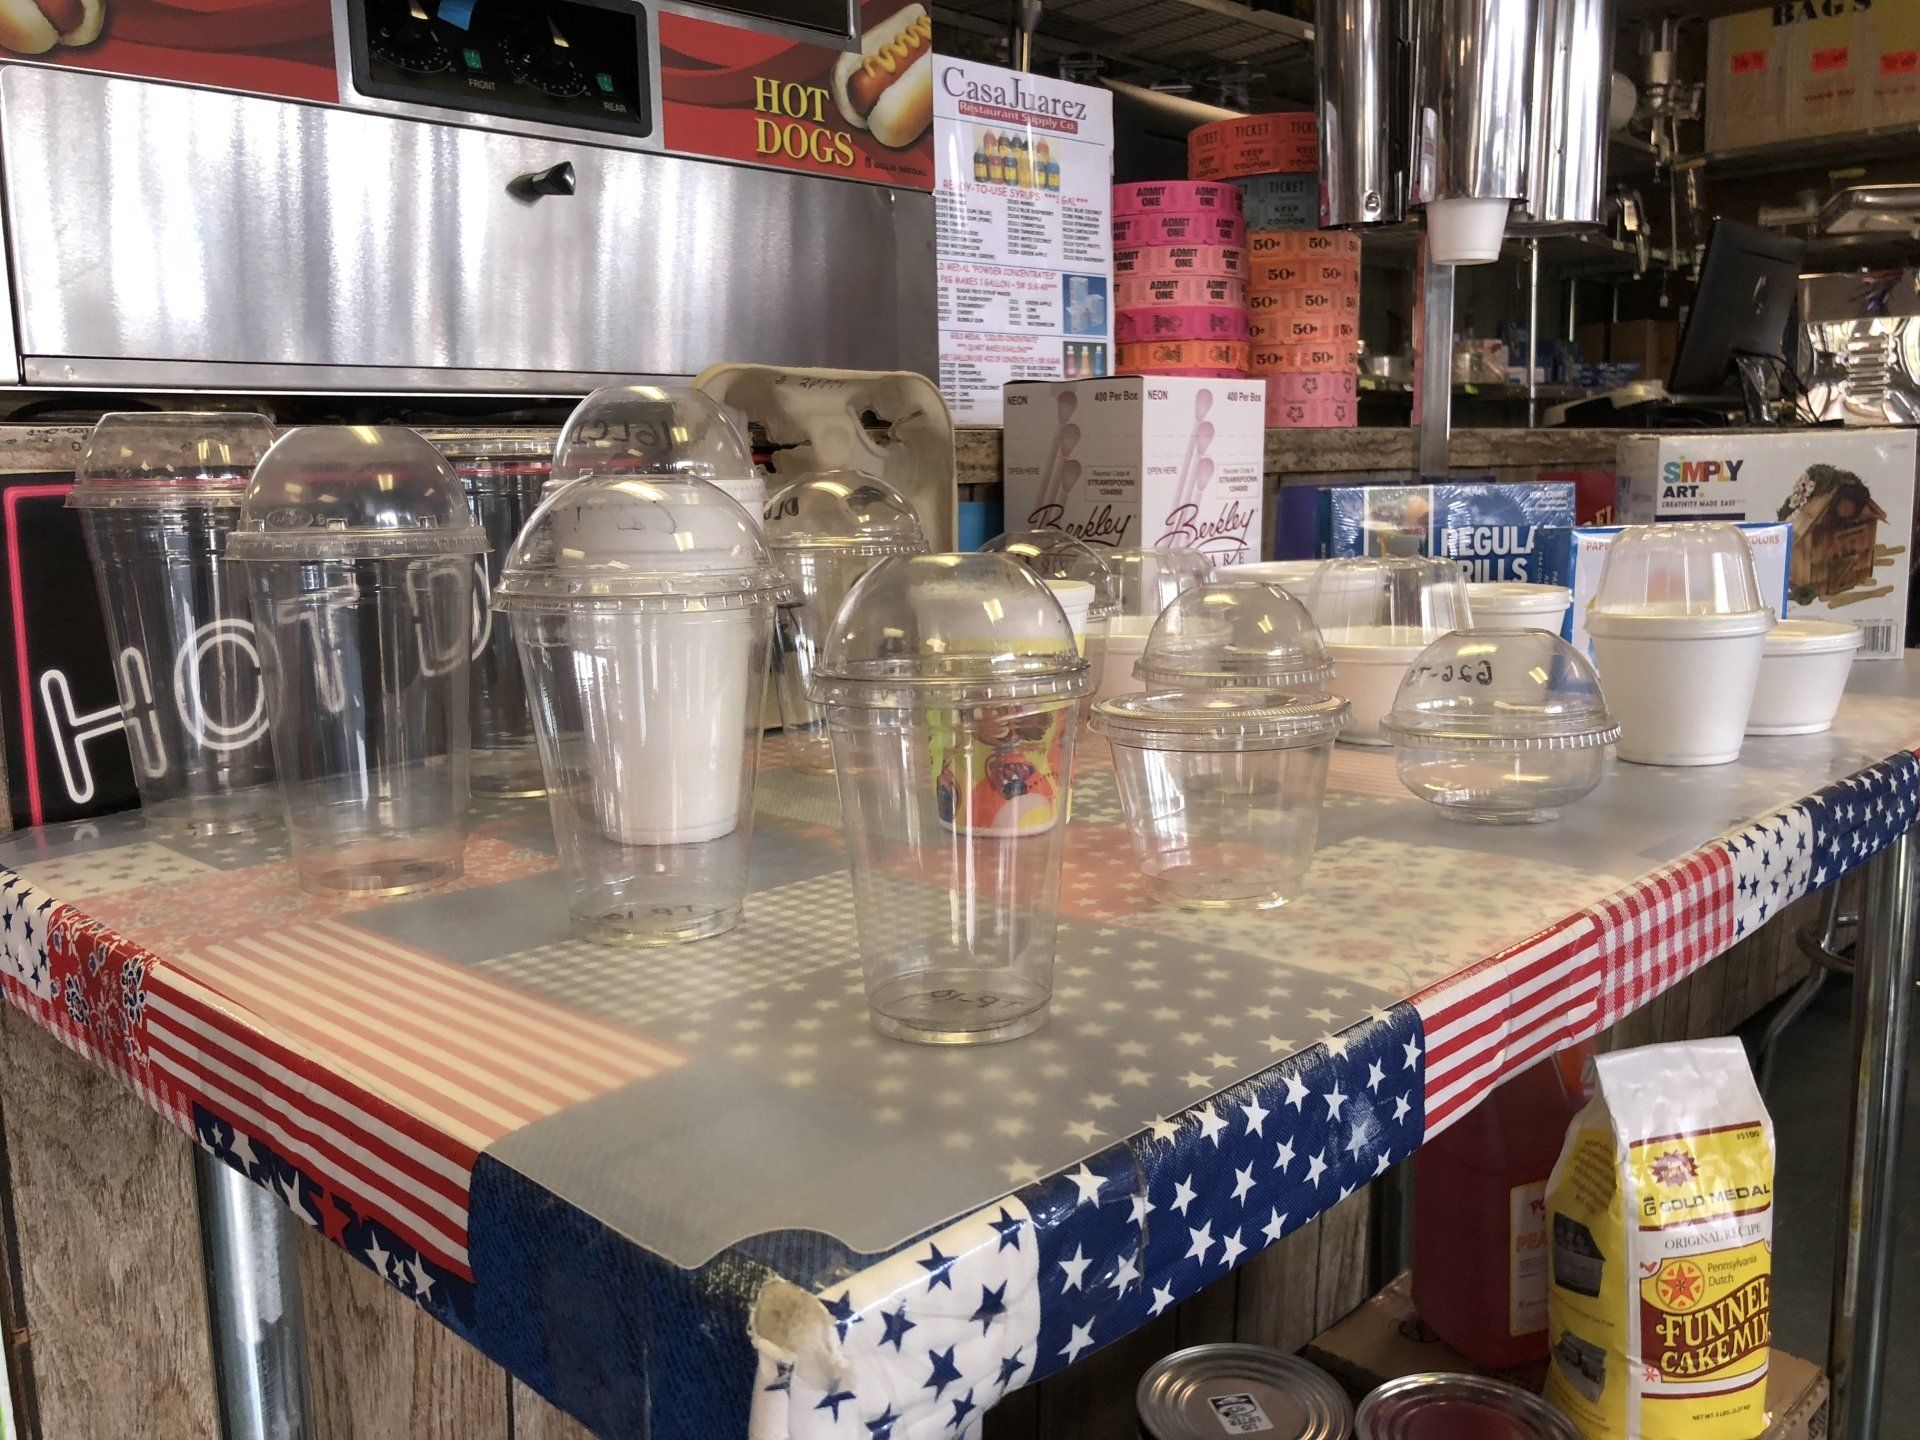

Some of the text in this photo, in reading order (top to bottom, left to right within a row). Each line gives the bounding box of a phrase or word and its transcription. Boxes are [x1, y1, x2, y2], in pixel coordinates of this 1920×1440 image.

[468, 78, 497, 92] FRONT
[753, 76, 830, 123] HOT
[603, 101, 627, 114] REAR
[959, 101, 1019, 121] Restaurant
[1022, 113, 1058, 130] Supply
[1235, 123, 1269, 139] TICKET
[754, 117, 855, 167] DOGS
[1233, 159, 1271, 171] COUPON
[1136, 187, 1166, 197] ADMIT
[1195, 187, 1219, 197] ADMIT
[1269, 181, 1305, 194] TICKET
[1142, 197, 1161, 207] ONE
[1200, 197, 1215, 207] ONE
[1113, 221, 1131, 232] MIT
[1162, 218, 1191, 228] ADMIT
[1167, 228, 1186, 237] ONE
[1169, 248, 1198, 258] ADMIT
[1116, 261, 1134, 271] ONE
[1174, 258, 1194, 268] ONE
[1150, 280, 1179, 291] ADMIT
[1206, 280, 1227, 290] ADMIT
[1155, 290, 1174, 300] ONE
[1210, 290, 1225, 299] ONE
[1007, 395, 1028, 406] NEON
[1094, 391, 1139, 401] 400 Per Box
[1147, 390, 1168, 400] NEON
[1239, 392, 1249, 401] Per
[1250, 392, 1262, 402] Box
[1008, 467, 1040, 476] OPEN HERE
[1147, 467, 1178, 475] OPEN HERE
[1699, 500, 1718, 508] MADE
[1028, 504, 1132, 548] Berkley
[1162, 501, 1254, 552] Berkley
[1441, 525, 1537, 557] REGULA
[1455, 558, 1528, 584] RILLS
[1659, 1195, 1705, 1213] GOLD
[1708, 1183, 1771, 1204] MEDAL
[1664, 1222, 1762, 1250] ORIGINAL RECIPE
[1707, 1255, 1758, 1274] Pennsylvania
[1708, 1274, 1734, 1288] Dutch
[1656, 1278, 1771, 1347] FUNNEL
